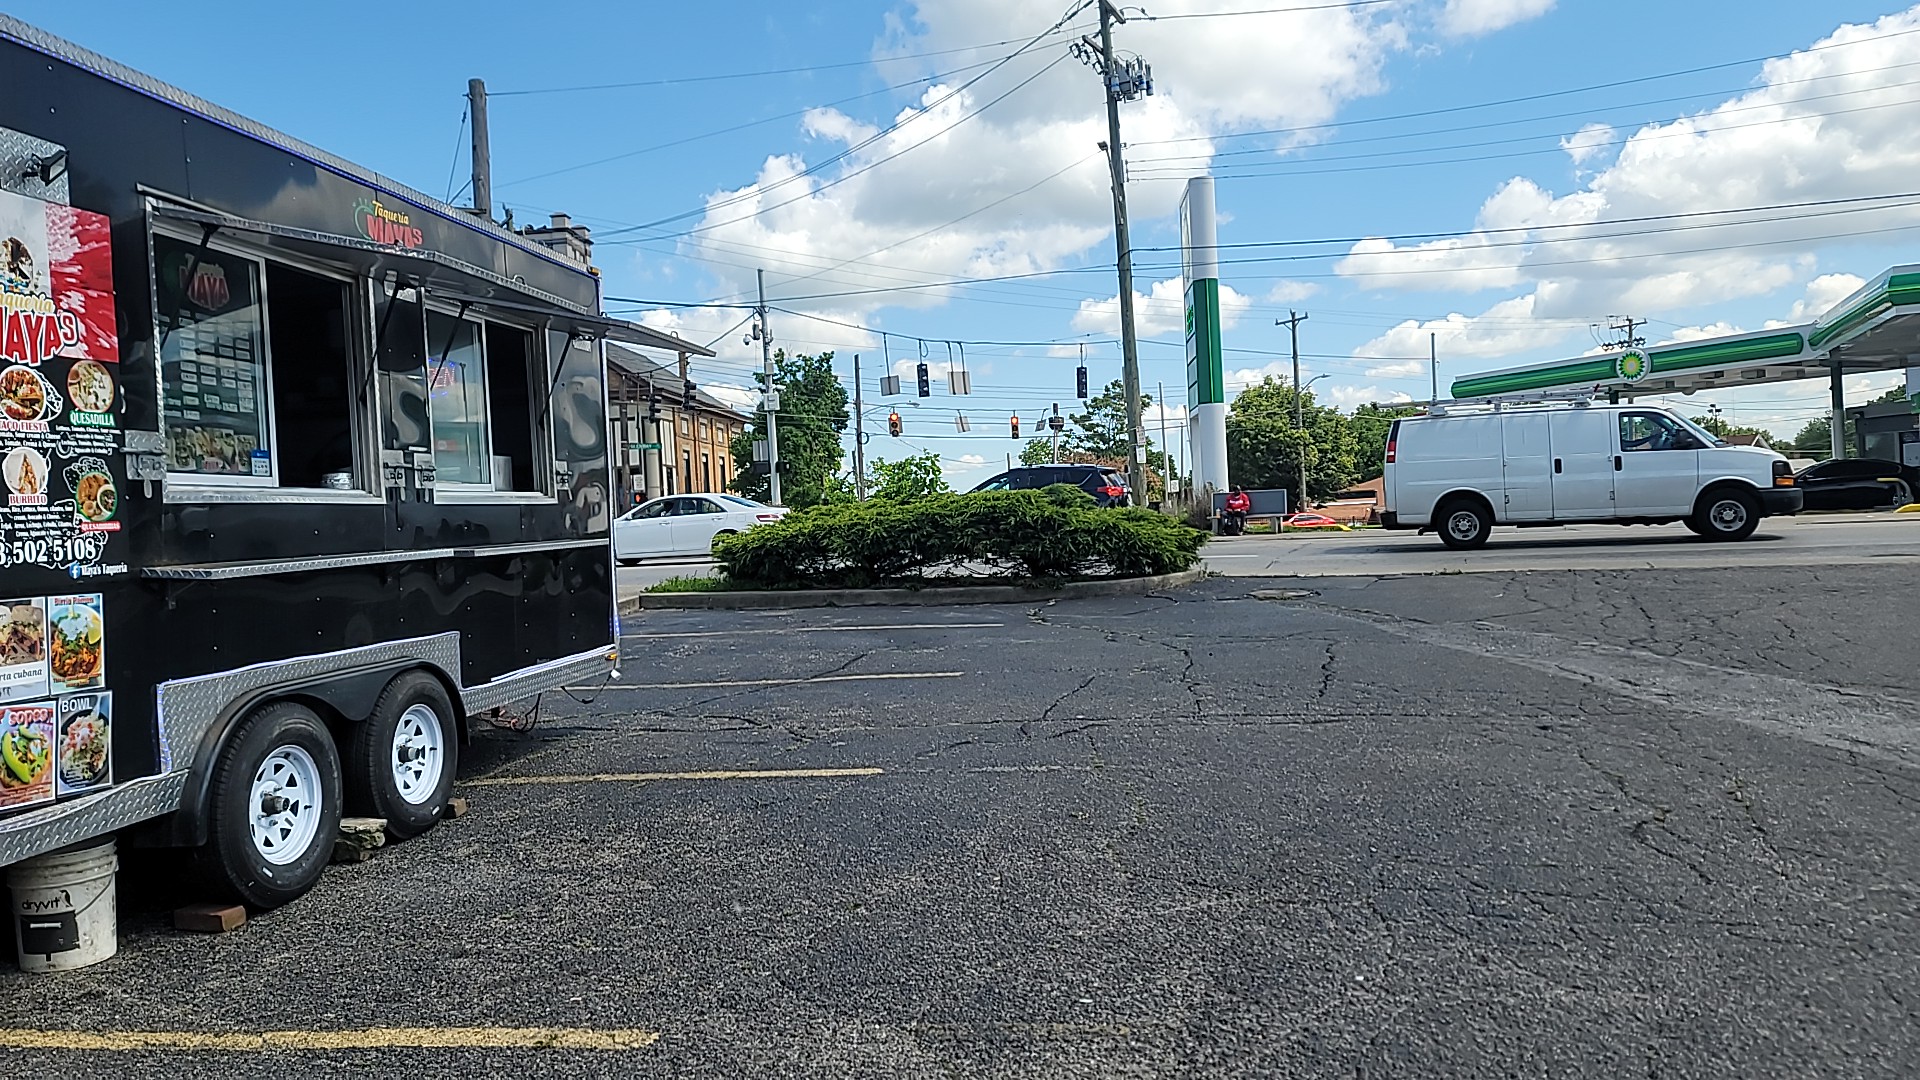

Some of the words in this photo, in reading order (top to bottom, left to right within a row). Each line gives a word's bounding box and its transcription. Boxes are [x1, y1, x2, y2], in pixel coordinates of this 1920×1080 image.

[372, 200, 409, 224] Taqueria
[0, 306, 79, 366] AYA'S
[20, 421, 49, 432] FIESTA
[70, 411, 115, 426] QUESADILLA
[9, 495, 47, 504] BURRITO
[13, 540, 47, 563] 502
[53, 538, 96, 560] 5108
[82, 563, 101, 577] Maya's
[102, 561, 128, 577] Taqueria
[13, 668, 43, 680] cubana
[61, 697, 93, 713] BOWL
[22, 896, 60, 913] dryvit
